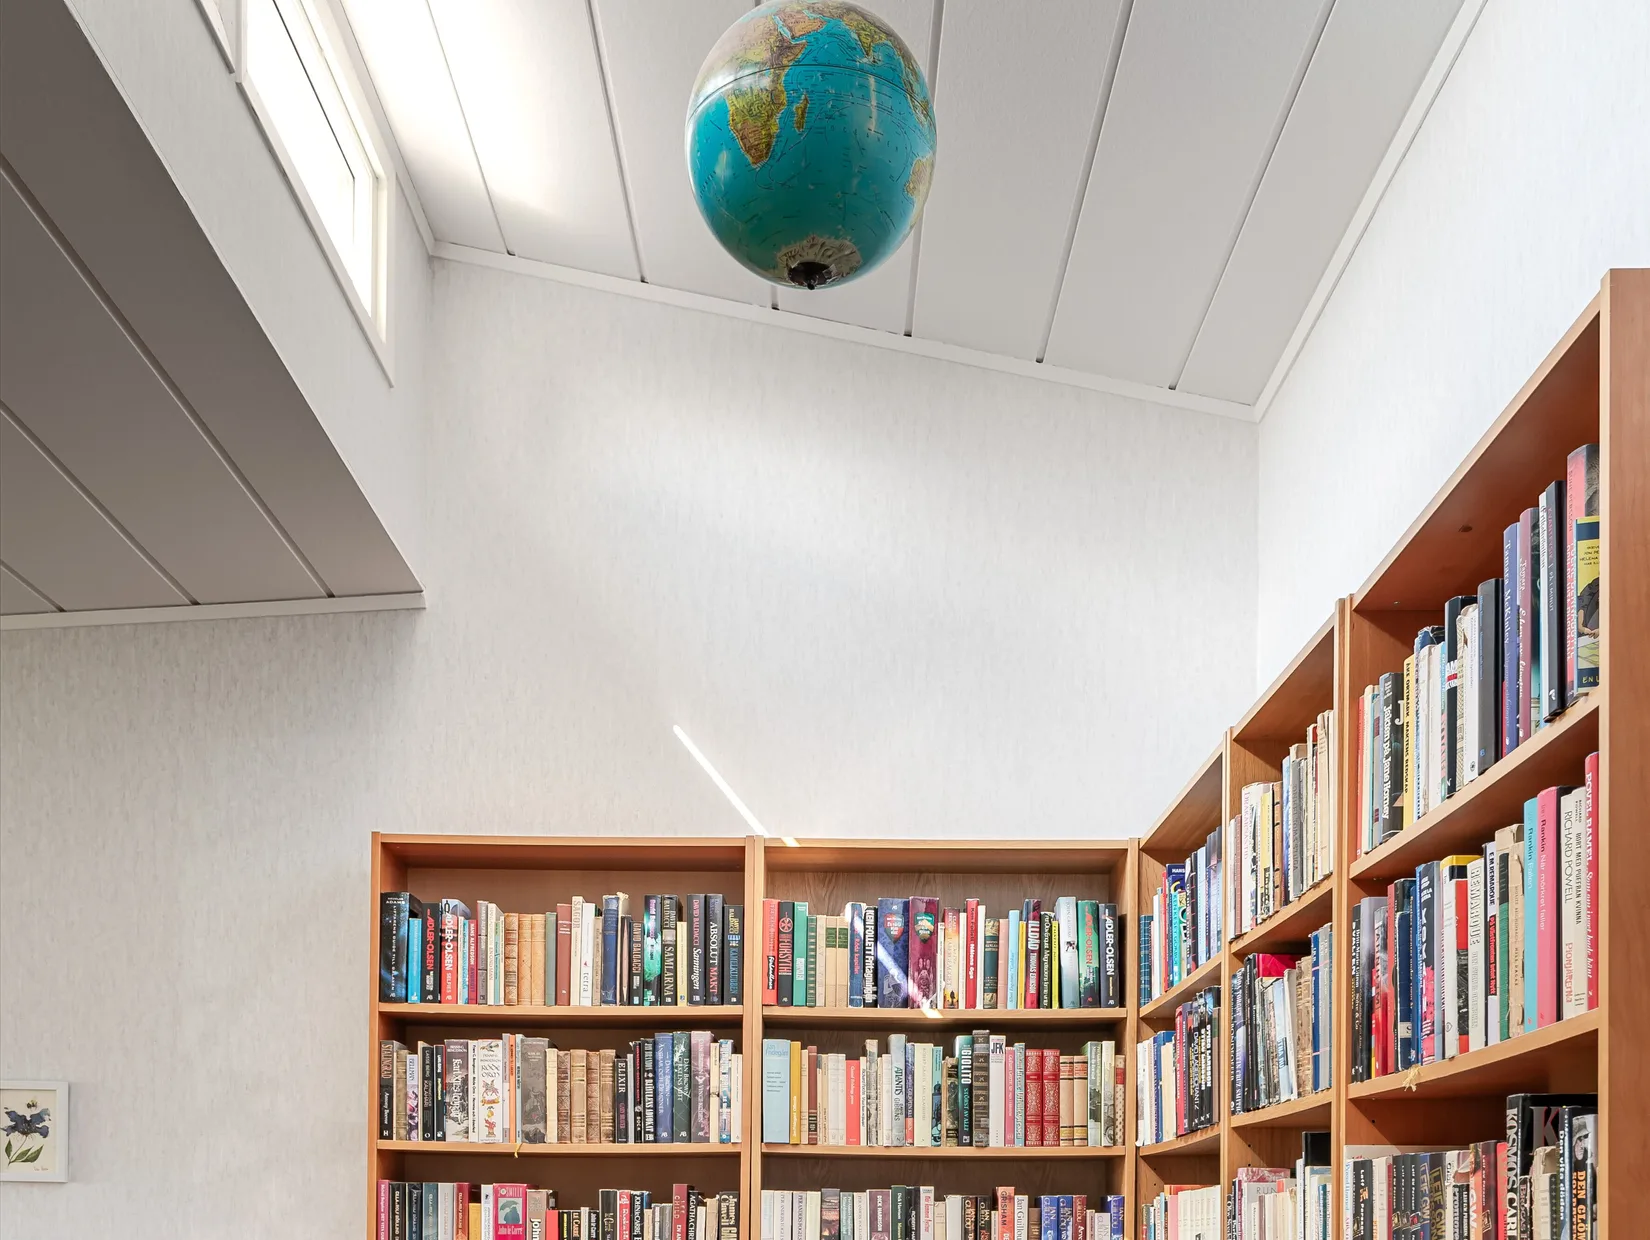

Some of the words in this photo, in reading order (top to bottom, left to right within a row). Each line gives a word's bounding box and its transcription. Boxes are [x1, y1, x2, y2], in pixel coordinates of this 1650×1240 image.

[1503, 540, 1511, 585] Tamara
[1503, 589, 1512, 645] McKinley
[1382, 704, 1391, 742] Jakten
[1381, 743, 1391, 755] på
[1382, 756, 1391, 782] Jane
[1381, 782, 1391, 820] Horney
[1564, 811, 1573, 859] RICHARD
[1575, 853, 1583, 868] MED
[1539, 874, 1547, 908] mörkret
[1564, 860, 1573, 904] POWELL
[572, 900, 581, 929] SAGOR
[865, 909, 875, 925] KEN
[1469, 867, 1481, 946] REMARQUE
[426, 915, 435, 970] ADLER-OLSEN
[444, 912, 454, 971] ADLER-OLSEN
[632, 922, 641, 942] DAVID
[865, 925, 875, 956] FOLLETT
[1027, 920, 1041, 951] ILLDÅD
[1106, 917, 1115, 976] ADLER-OLSEN
[582, 972, 590, 992] tetra
[664, 946, 674, 996] SAMLARNA
[691, 948, 702, 990] Sanningen
[729, 947, 738, 994] KAMELKLUBBEN
[381, 1044, 393, 1079] STALINGRAD
[990, 1042, 1004, 1054] JFK
[617, 1062, 626, 1093] ELIXIR
[894, 1066, 904, 1096] ATLANTIS
[961, 1049, 972, 1085] GIOLITO
[1507, 1107, 1519, 1189] KOSMOS
[1430, 1170, 1442, 1205] LEIF
[1576, 1171, 1586, 1199] DEN
[688, 1194, 696, 1222] AGATHA
[1015, 1197, 1025, 1210] Jan
[1507, 1192, 1518, 1235] CARL
[1519, 1184, 1529, 1231] BROCAS
[1015, 1211, 1025, 1240] Guillou
[1435, 1208, 1445, 1238] GW
